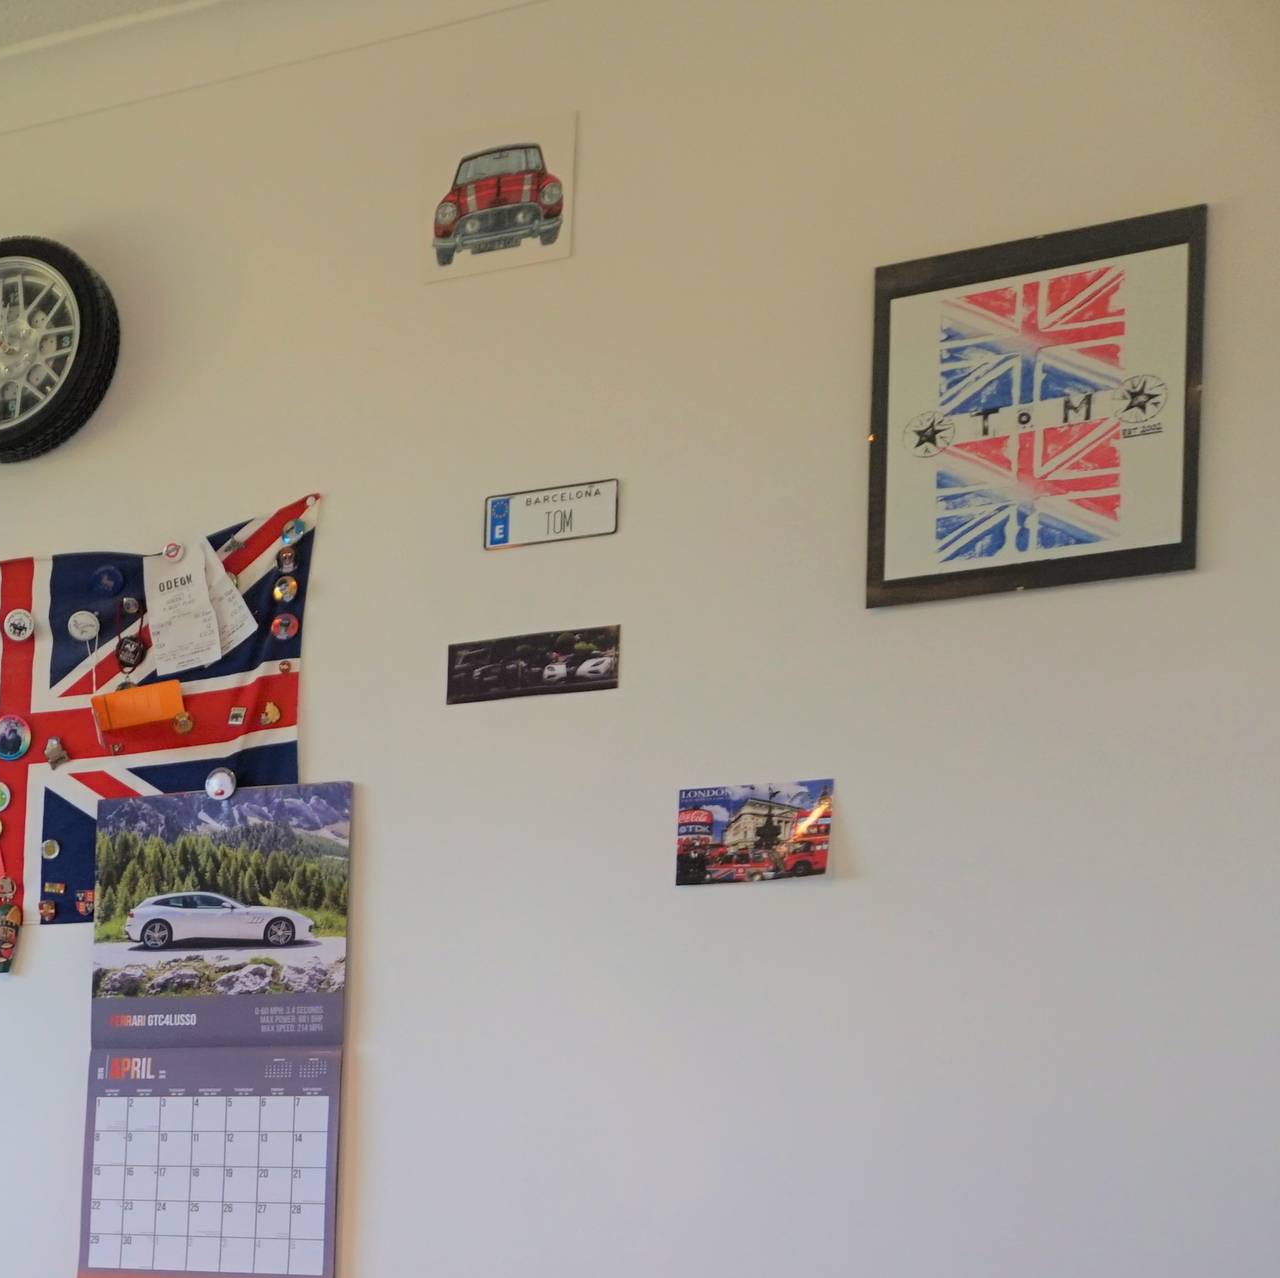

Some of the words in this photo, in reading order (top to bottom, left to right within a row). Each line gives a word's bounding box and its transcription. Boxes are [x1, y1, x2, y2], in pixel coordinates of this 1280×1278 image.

[525, 488, 601, 507] BARCELONA
[495, 524, 505, 538] E
[545, 508, 573, 535] TOM
[159, 574, 193, 592] ODEON
[147, 1013, 197, 1026] GTC4LUSSO
[111, 1056, 155, 1080] APRIL
[160, 1133, 168, 1142] 10
[193, 1133, 199, 1142] 11
[227, 1133, 234, 1142] 12
[260, 1133, 268, 1142] 13
[294, 1133, 303, 1142] 14
[93, 1167, 101, 1176] 15
[127, 1167, 134, 1177] 16
[159, 1168, 166, 1177] 17
[192, 1168, 200, 1178] 18
[225, 1168, 233, 1178] 19
[259, 1169, 269, 1178] 20
[292, 1169, 301, 1179] 21
[91, 1201, 101, 1210] 22
[124, 1201, 134, 1211] 23
[157, 1202, 166, 1211] 24
[190, 1203, 200, 1212] 25
[223, 1204, 233, 1213] 26
[257, 1204, 267, 1213] 27
[291, 1205, 302, 1214] 28
[90, 1235, 100, 1244] 29
[122, 1236, 132, 1245] 30
